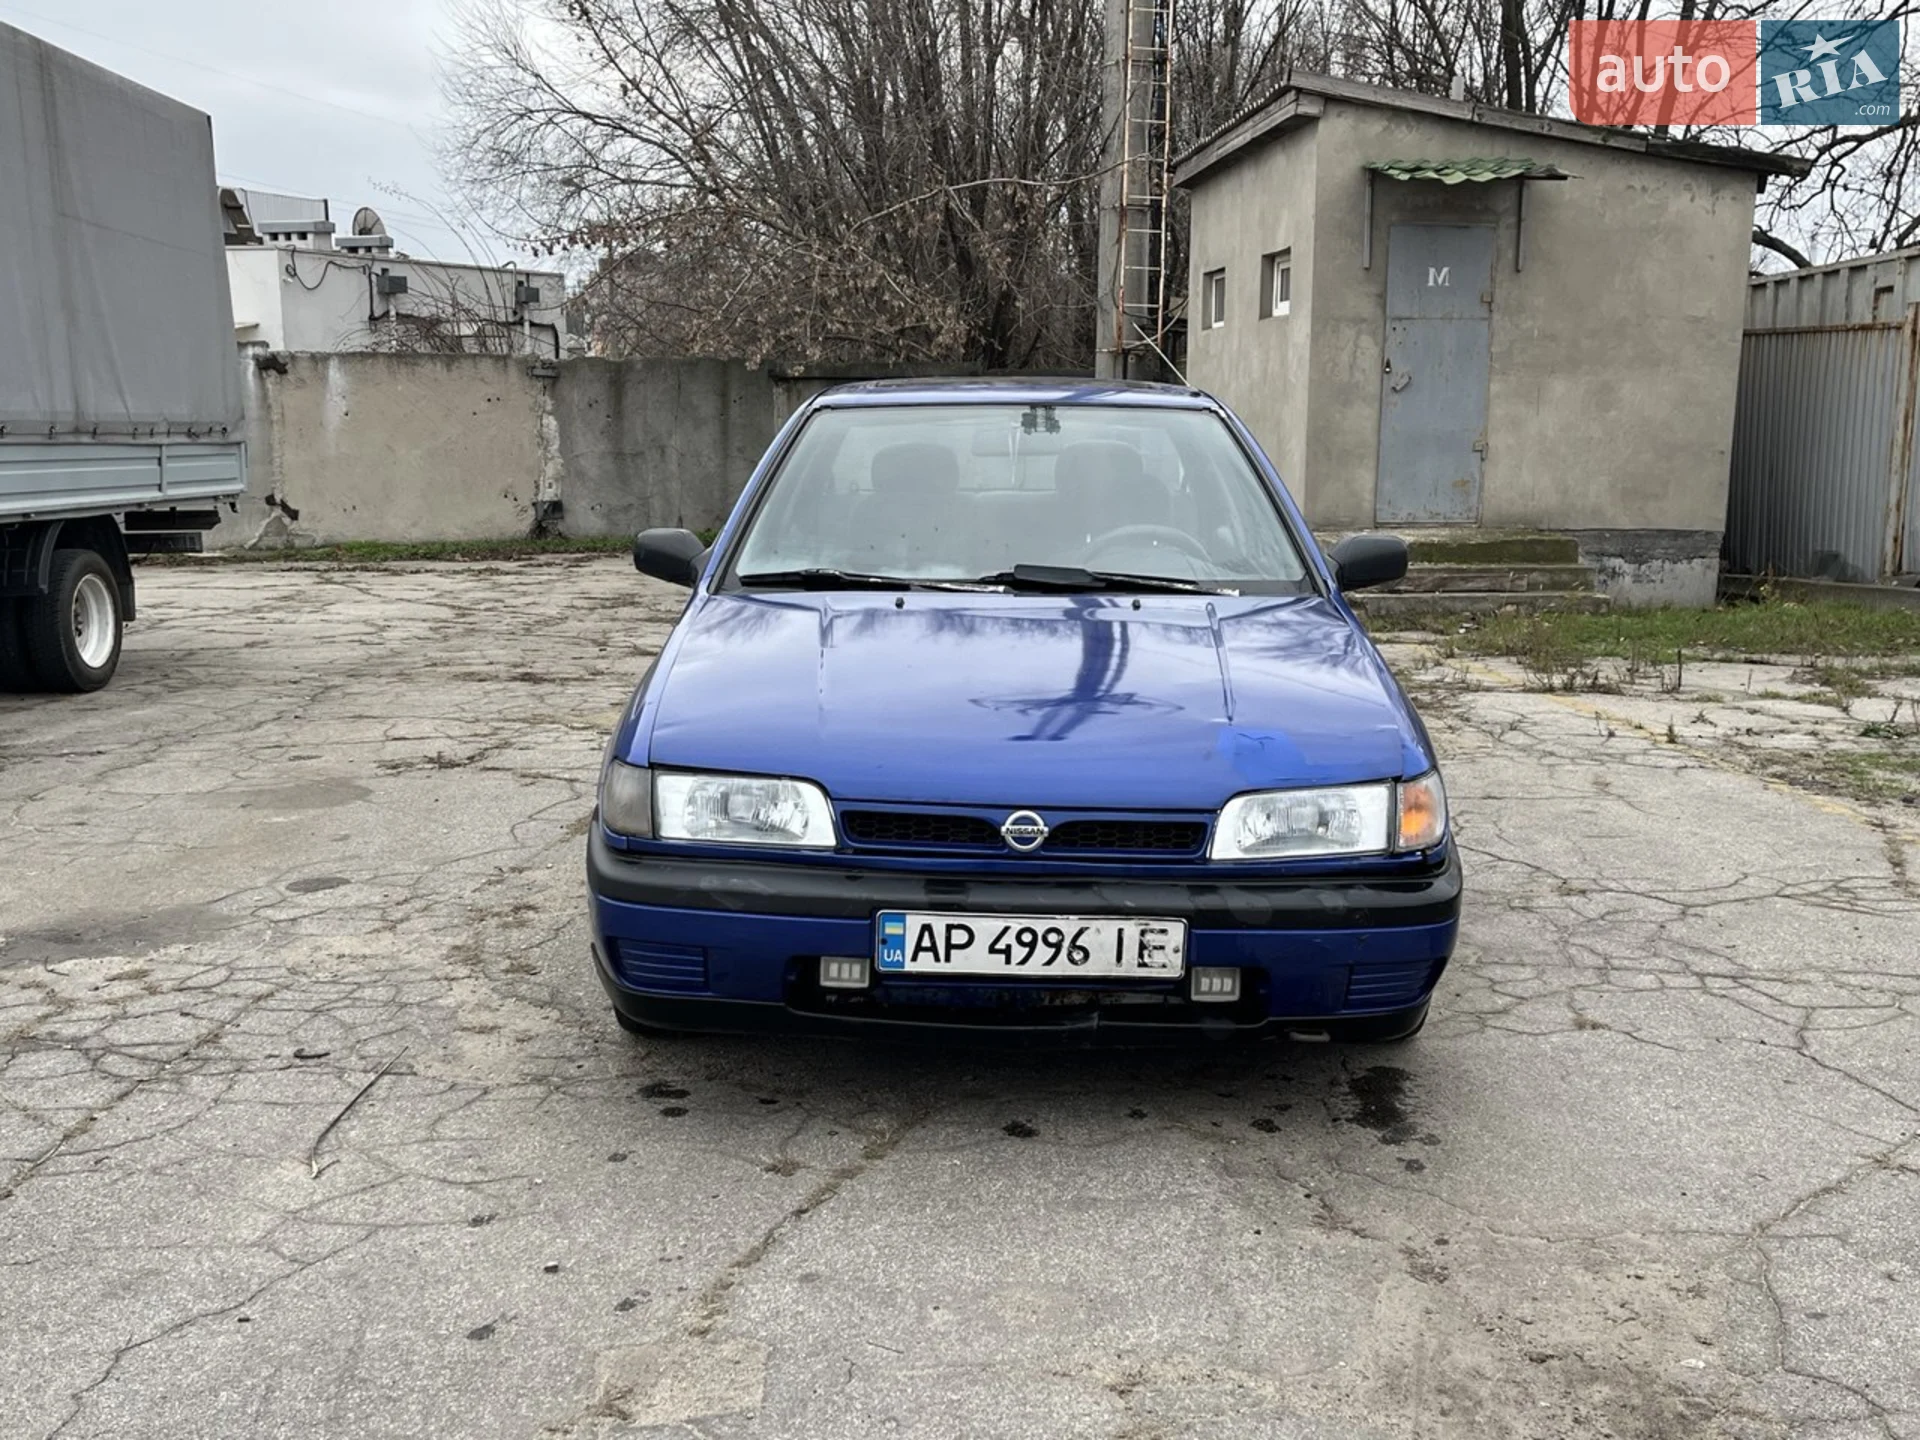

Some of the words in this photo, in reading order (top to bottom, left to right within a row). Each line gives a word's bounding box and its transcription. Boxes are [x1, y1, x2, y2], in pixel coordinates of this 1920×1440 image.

[1005, 827, 1044, 835] NISSAN
[910, 923, 975, 964] AP
[988, 925, 1090, 967] 4996
[883, 948, 903, 963] UA
